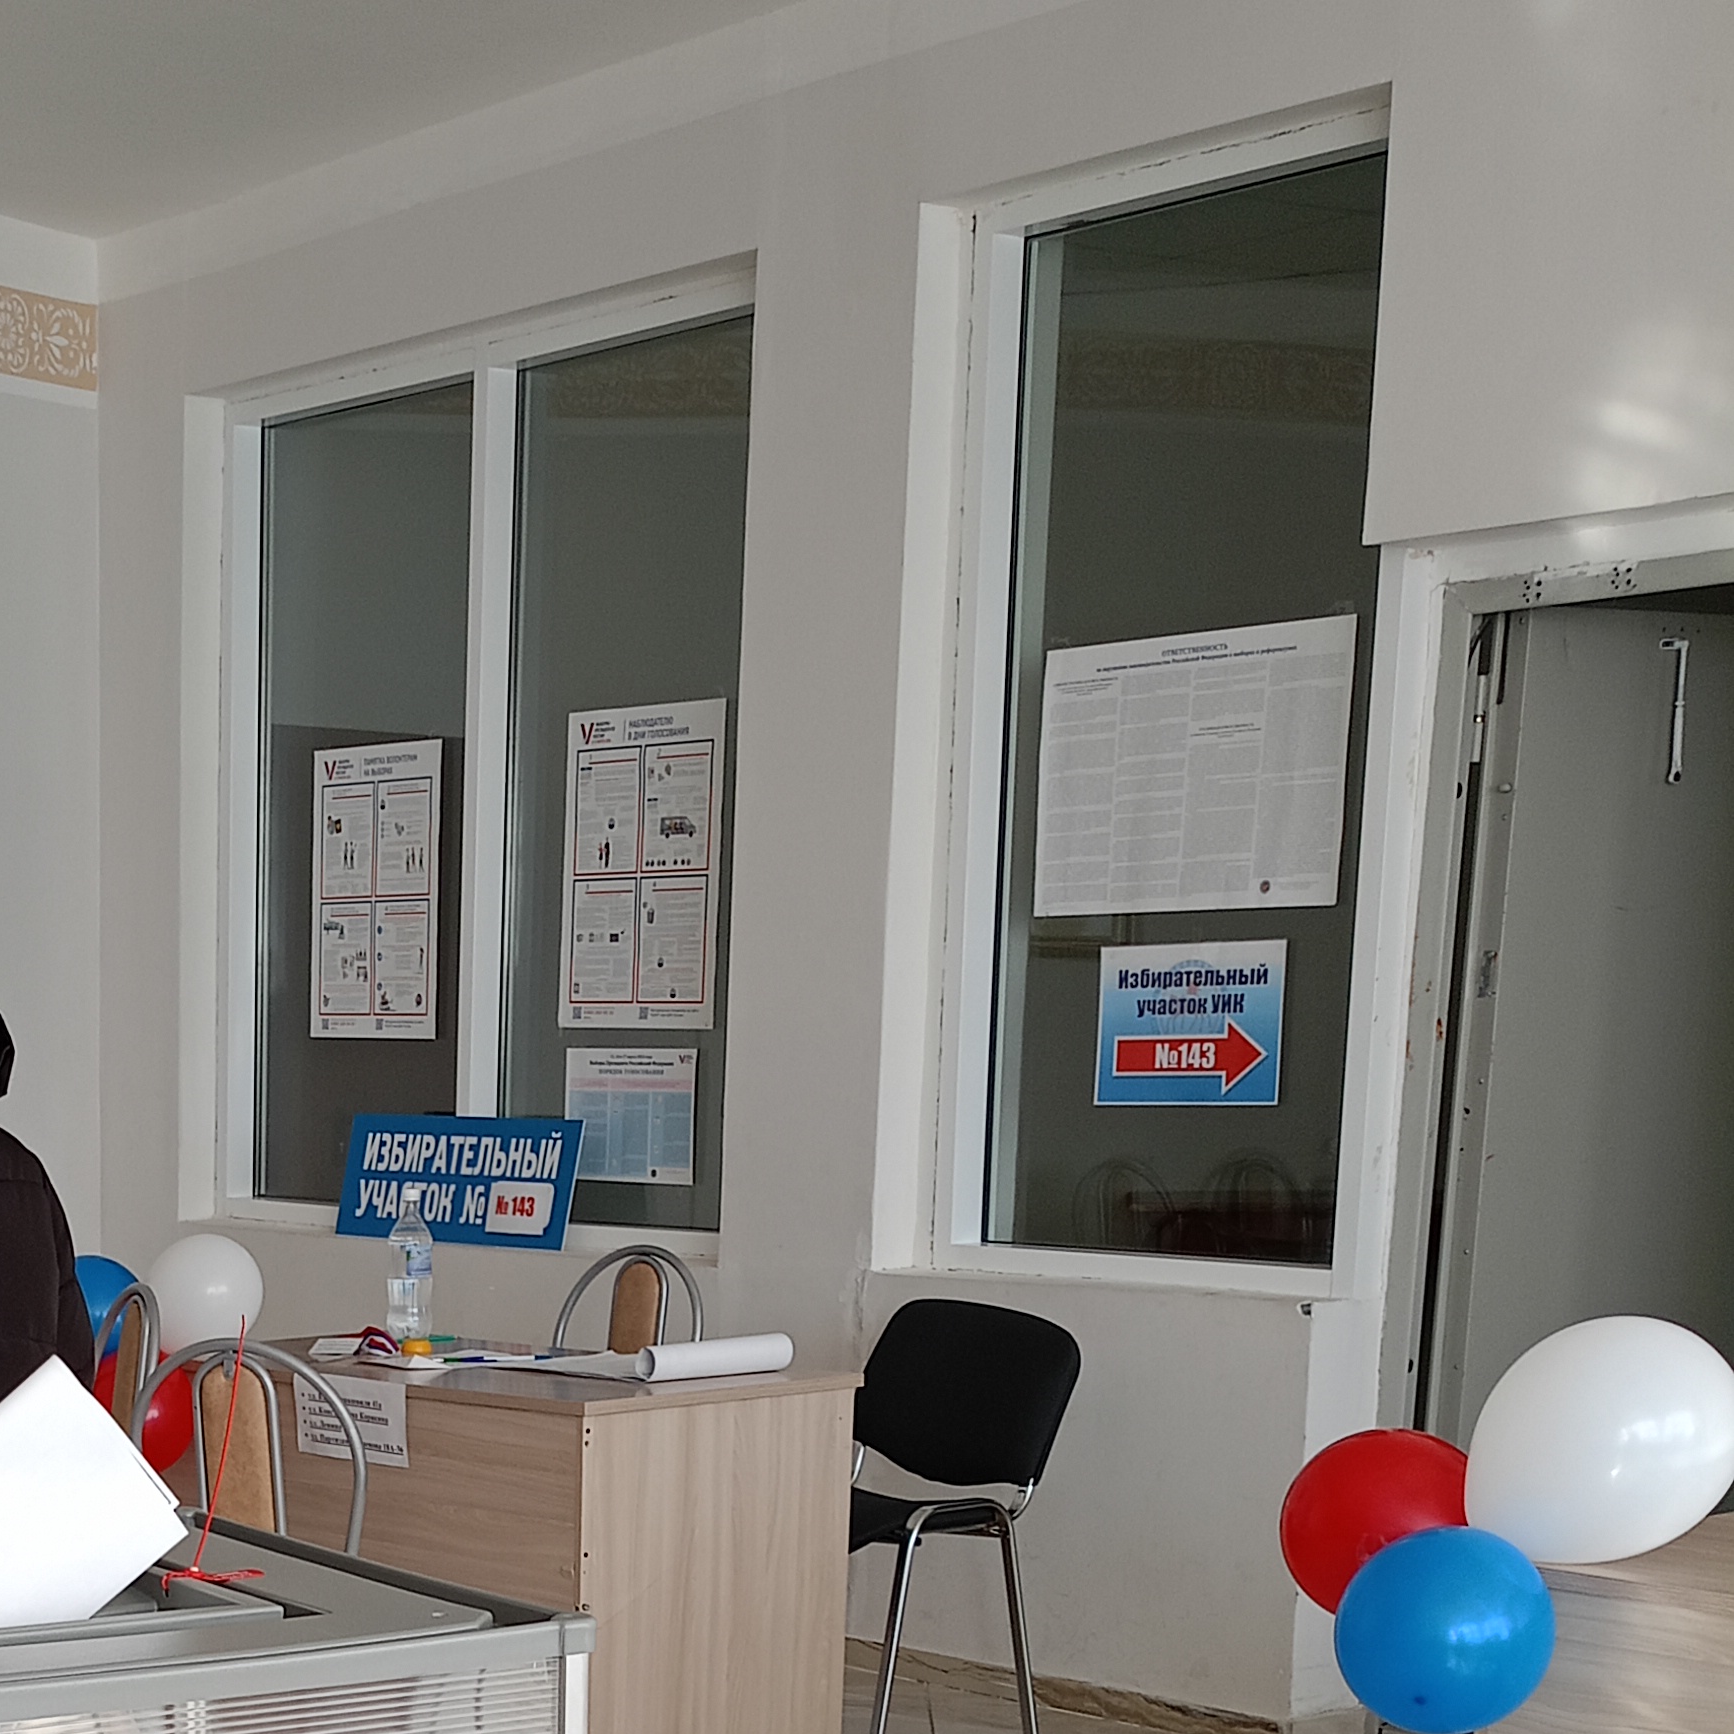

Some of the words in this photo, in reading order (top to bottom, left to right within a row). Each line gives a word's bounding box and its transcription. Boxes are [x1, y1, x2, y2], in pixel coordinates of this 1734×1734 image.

[1118, 963, 1269, 989] Избирательный
[1136, 997, 1208, 1018] участок
[1211, 993, 1245, 1014] УИК
[1154, 1042, 1216, 1069] №143
[363, 1131, 563, 1180] ИЗБИРАТЕЛЬНЫЙ
[511, 1196, 535, 1217] 143
